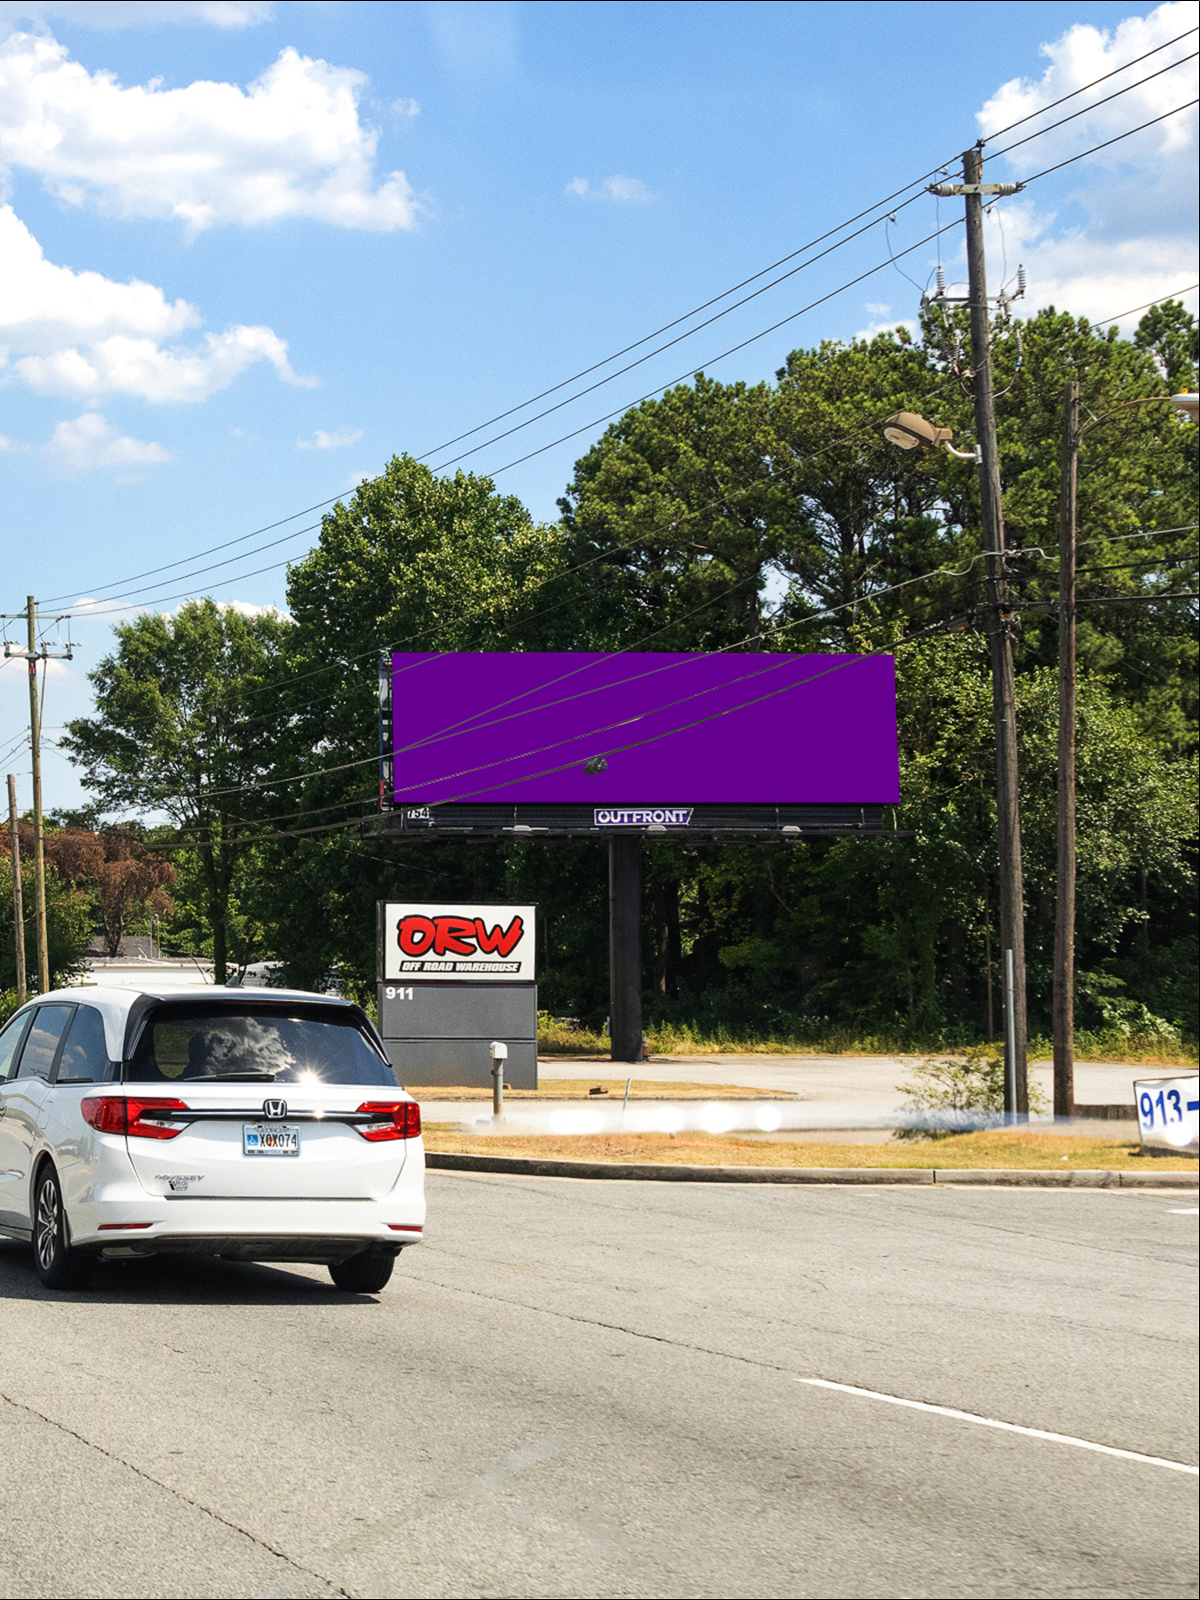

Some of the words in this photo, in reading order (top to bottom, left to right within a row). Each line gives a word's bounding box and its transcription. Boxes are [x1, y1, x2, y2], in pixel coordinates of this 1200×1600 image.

[598, 810, 688, 824] OUTFRONT
[397, 914, 525, 958] ORW
[402, 961, 422, 971] OFF
[423, 961, 453, 972] ROAD
[455, 962, 520, 973] WAREHOUSE
[385, 986, 414, 1000] 911
